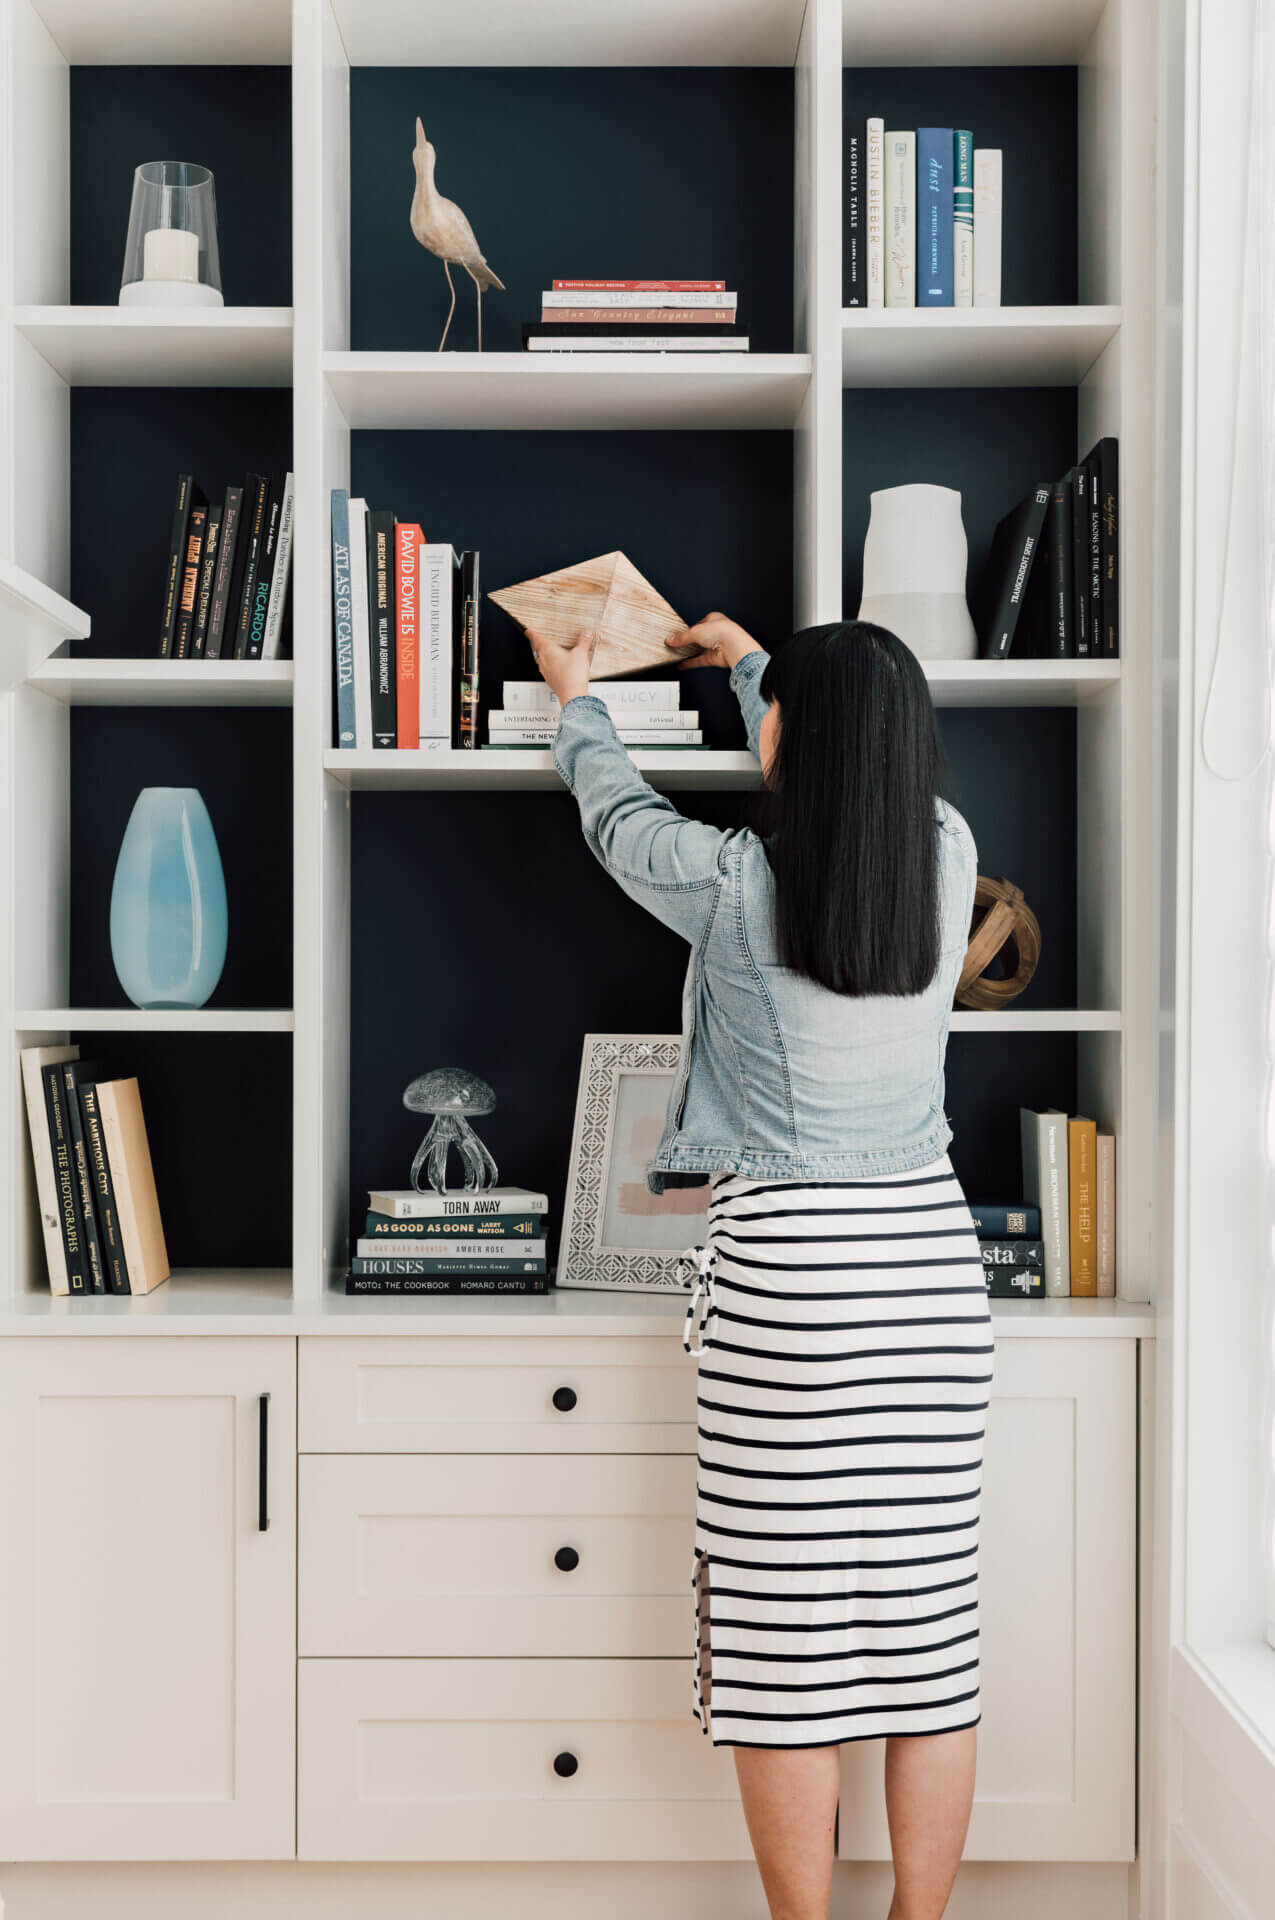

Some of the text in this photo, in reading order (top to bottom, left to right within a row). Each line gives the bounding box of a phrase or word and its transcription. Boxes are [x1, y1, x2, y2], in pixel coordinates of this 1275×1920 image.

[869, 127, 880, 180] JUSTIN
[959, 136, 968, 184] LONG MAN
[850, 138, 858, 228] MAGNOLIA TABLE
[869, 189, 880, 244] BIEBER
[201, 559, 214, 590] SPECIAL
[377, 532, 387, 609] AMERICAN ORIGINALS
[431, 568, 440, 607] INGRID
[1010, 536, 1035, 604] TRANSCENDENT SPIRIT
[1092, 572, 1100, 599] ARCTIC
[197, 592, 210, 630] DELIVERY
[251, 582, 269, 641] RICARDO
[335, 543, 353, 688] ATLAS OF CANADA
[400, 530, 415, 681] DAVID BOWIE IS INSIDE
[379, 618, 389, 695] WILLIAM ABRANOWICZ
[431, 609, 440, 661] BERGMAN
[621, 691, 657, 705] LUCY
[83, 1092, 109, 1196] THE AMBITIOUS CITY
[56, 1143, 79, 1253] THE PHOTOGRAPHS
[442, 1200, 501, 1215] TORN AWAY
[1079, 1183, 1089, 1205] THE
[375, 1223, 475, 1233] AS GOOD AS GONE
[1079, 1206, 1090, 1244] HELP
[362, 1260, 425, 1274] HOUSES
[982, 1246, 1016, 1264] sta
[355, 1281, 450, 1289] MOTO: THE COOKBOOK
[461, 1281, 526, 1289] HOMARO CANTU
